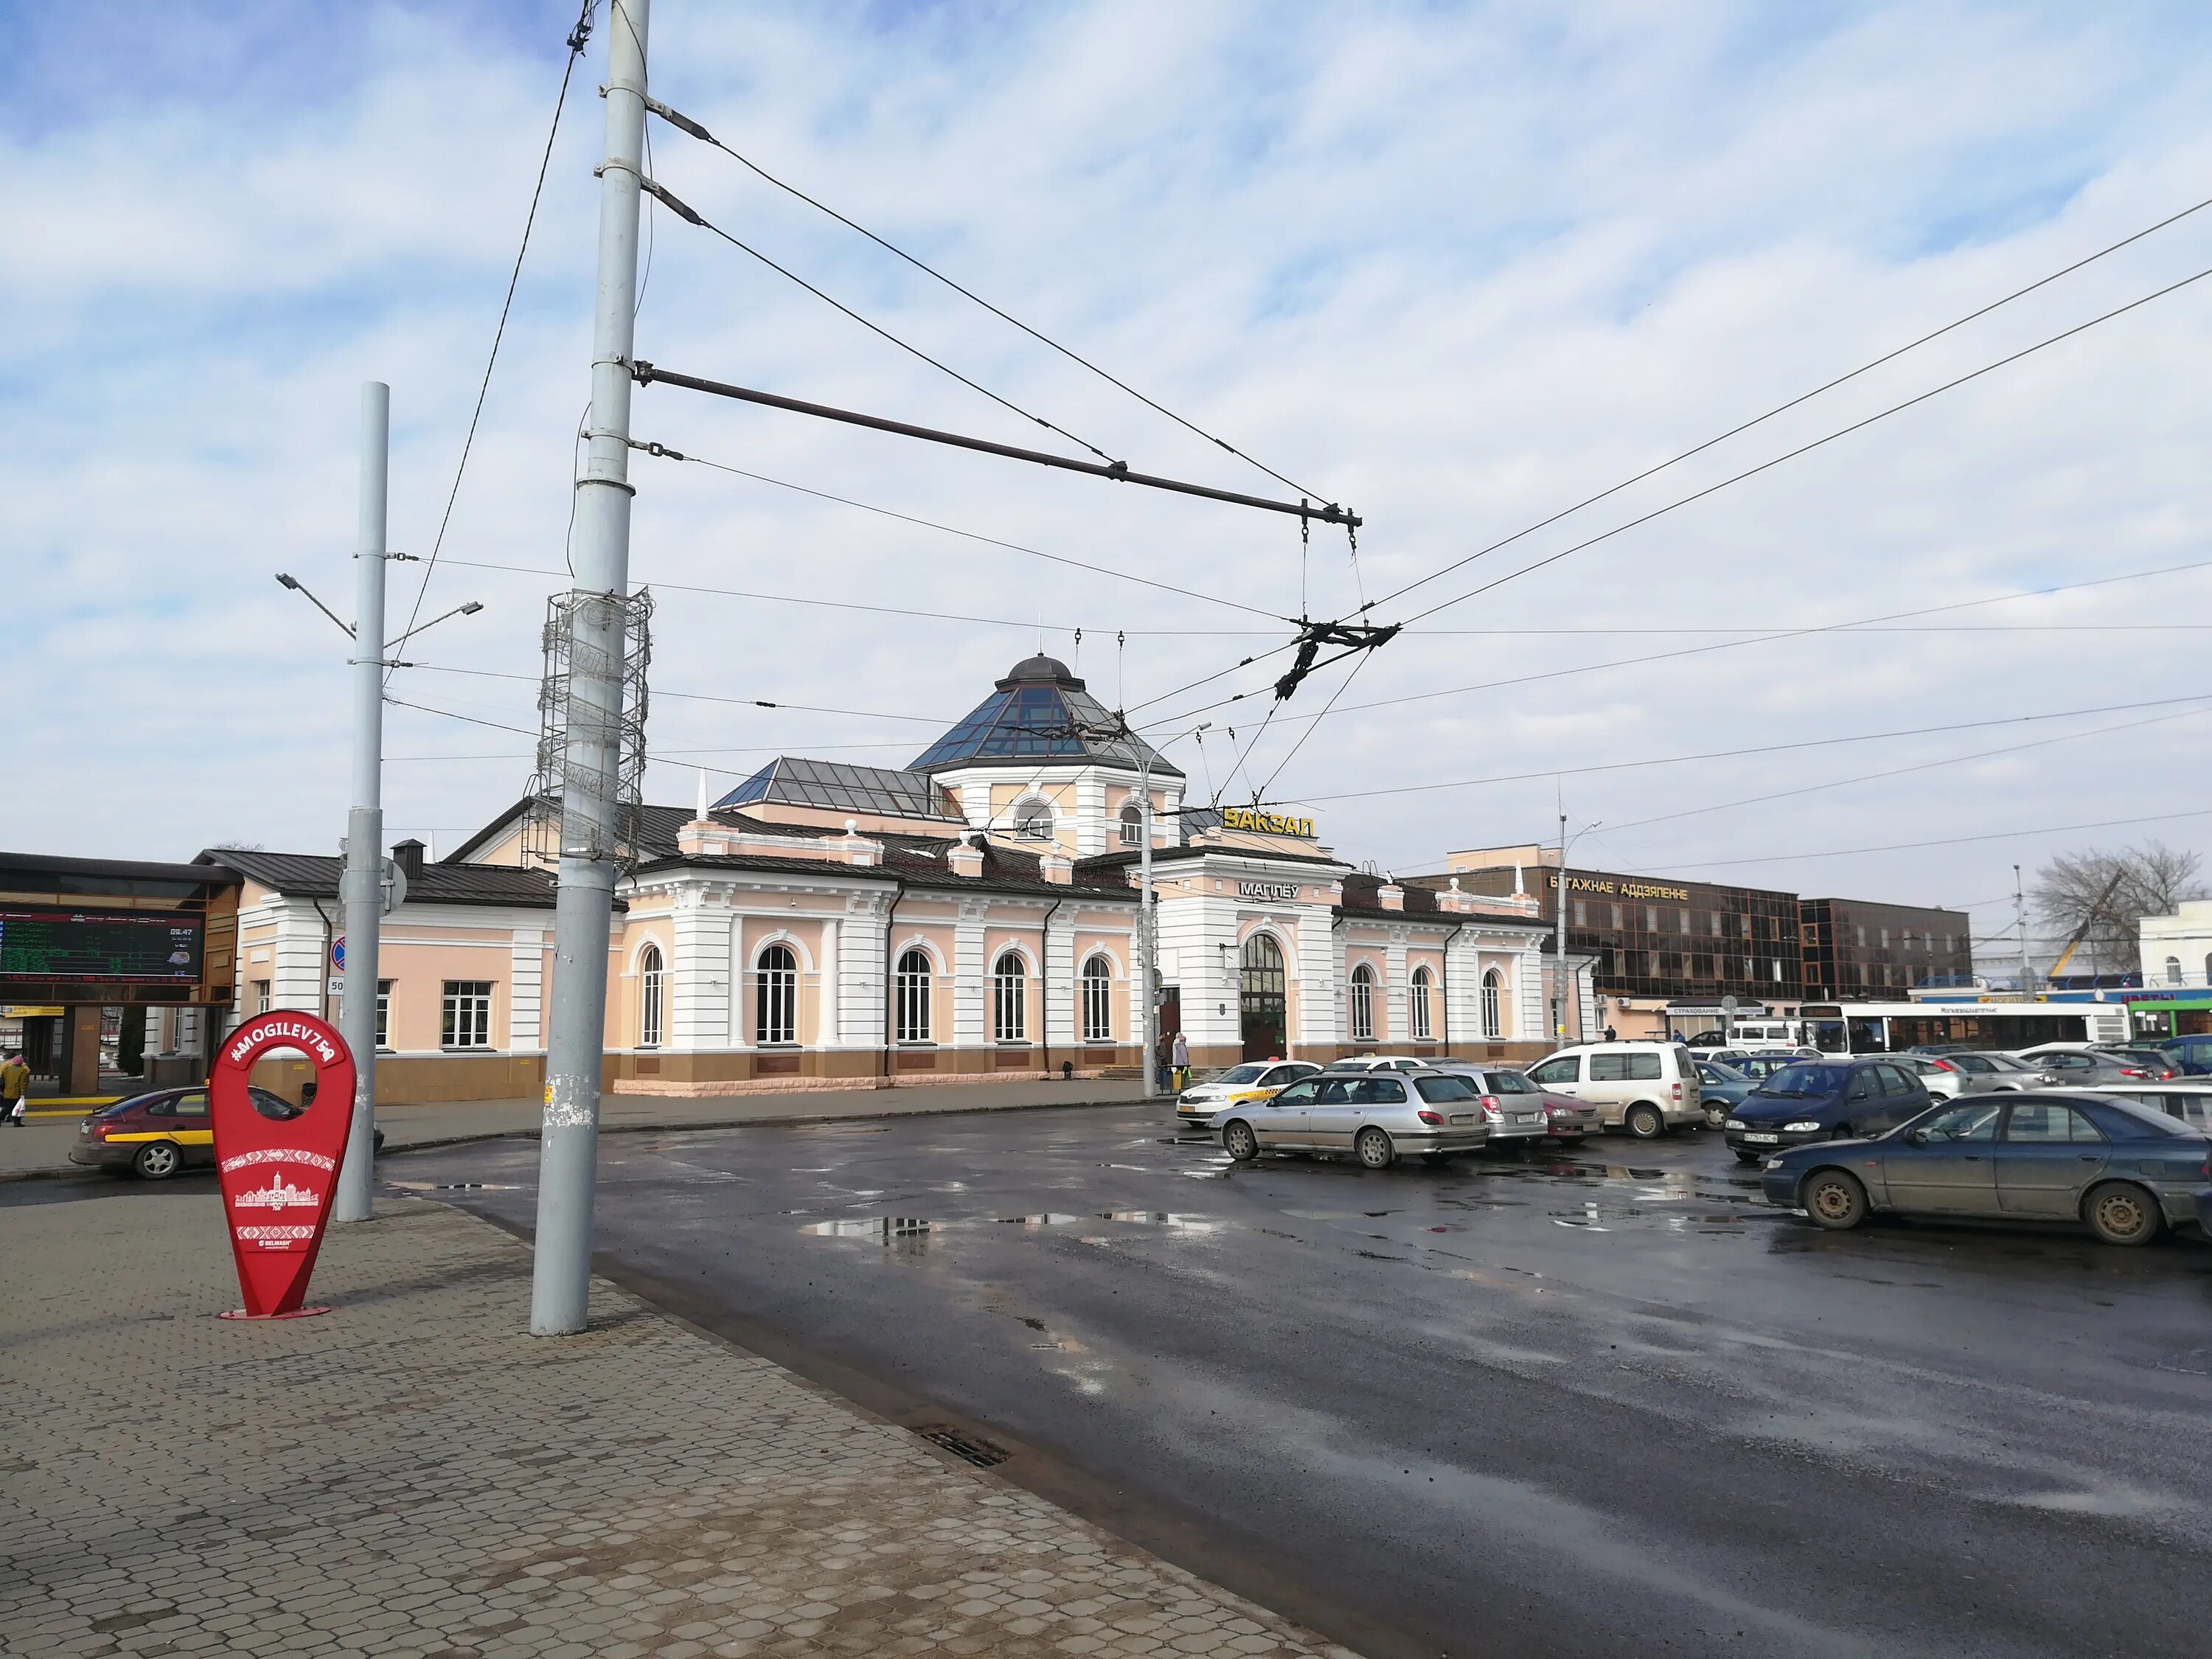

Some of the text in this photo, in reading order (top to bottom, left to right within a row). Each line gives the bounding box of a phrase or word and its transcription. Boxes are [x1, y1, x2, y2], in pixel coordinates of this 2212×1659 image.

[1224, 809, 1314, 837] ВАКЗАЛ
[1550, 875, 1688, 900] БГАЖНАЕ АДДЗЯЛЕННЕ
[231, 1022, 335, 1062] #MOGILEV750
